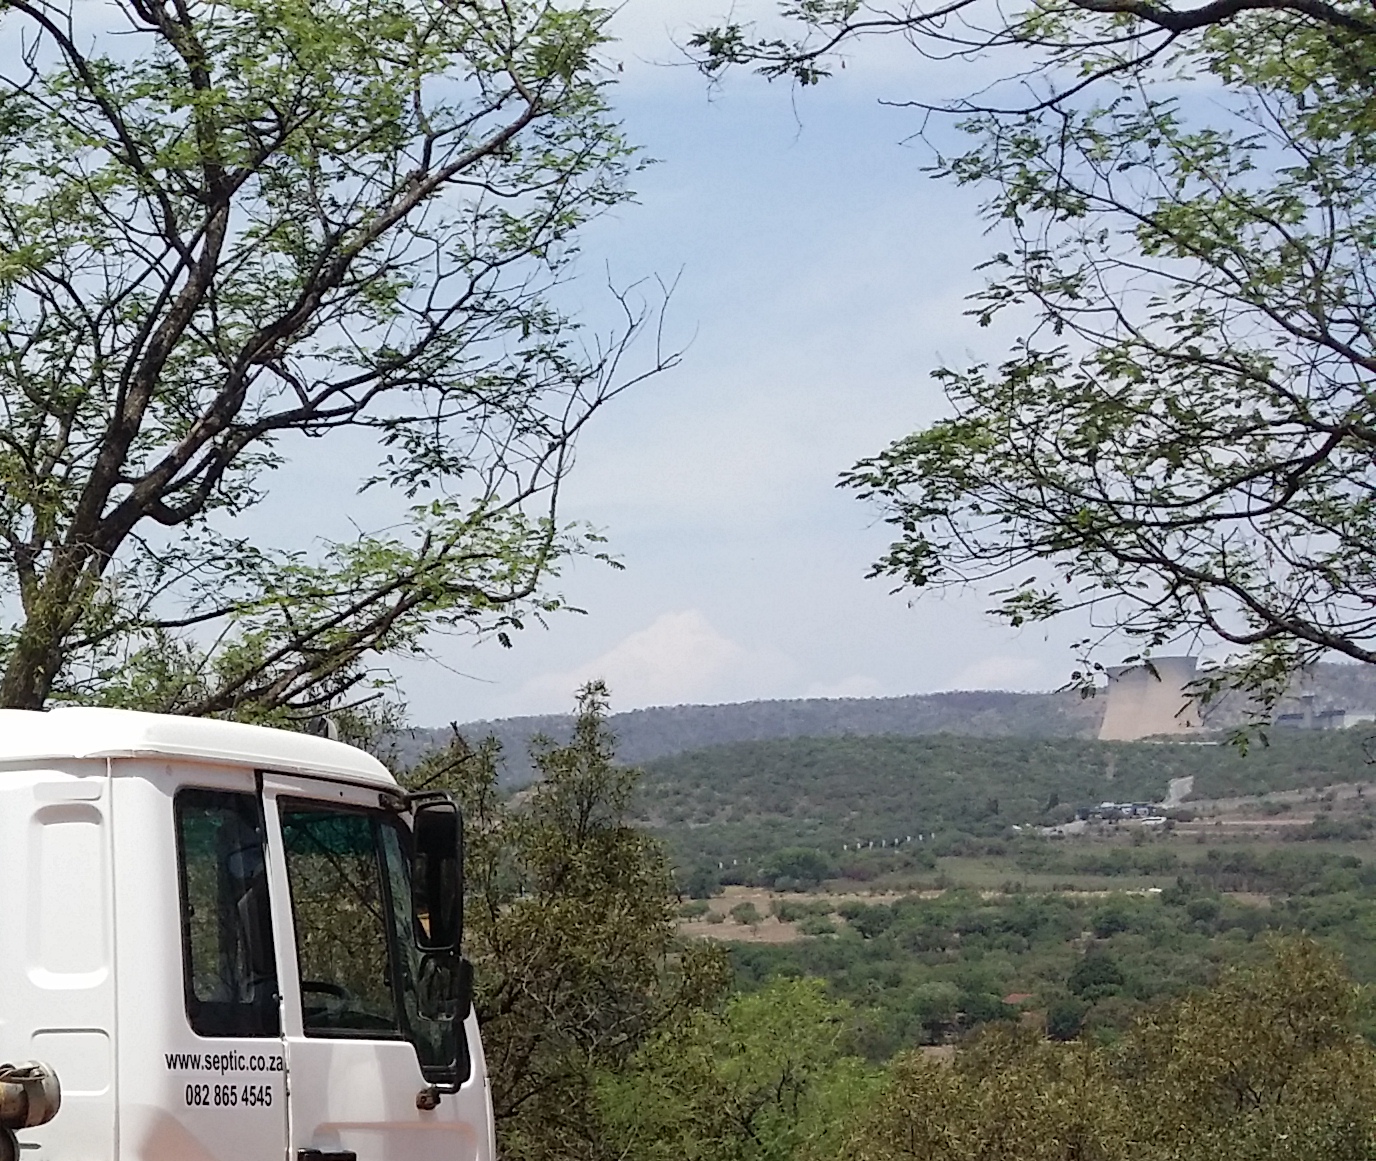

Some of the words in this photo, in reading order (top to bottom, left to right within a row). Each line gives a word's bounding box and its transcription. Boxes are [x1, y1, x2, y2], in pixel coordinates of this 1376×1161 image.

[164, 1050, 284, 1076] www.septic.co.za
[185, 1084, 210, 1106] 082
[214, 1084, 238, 1107] 865
[241, 1084, 273, 1107] 4545
